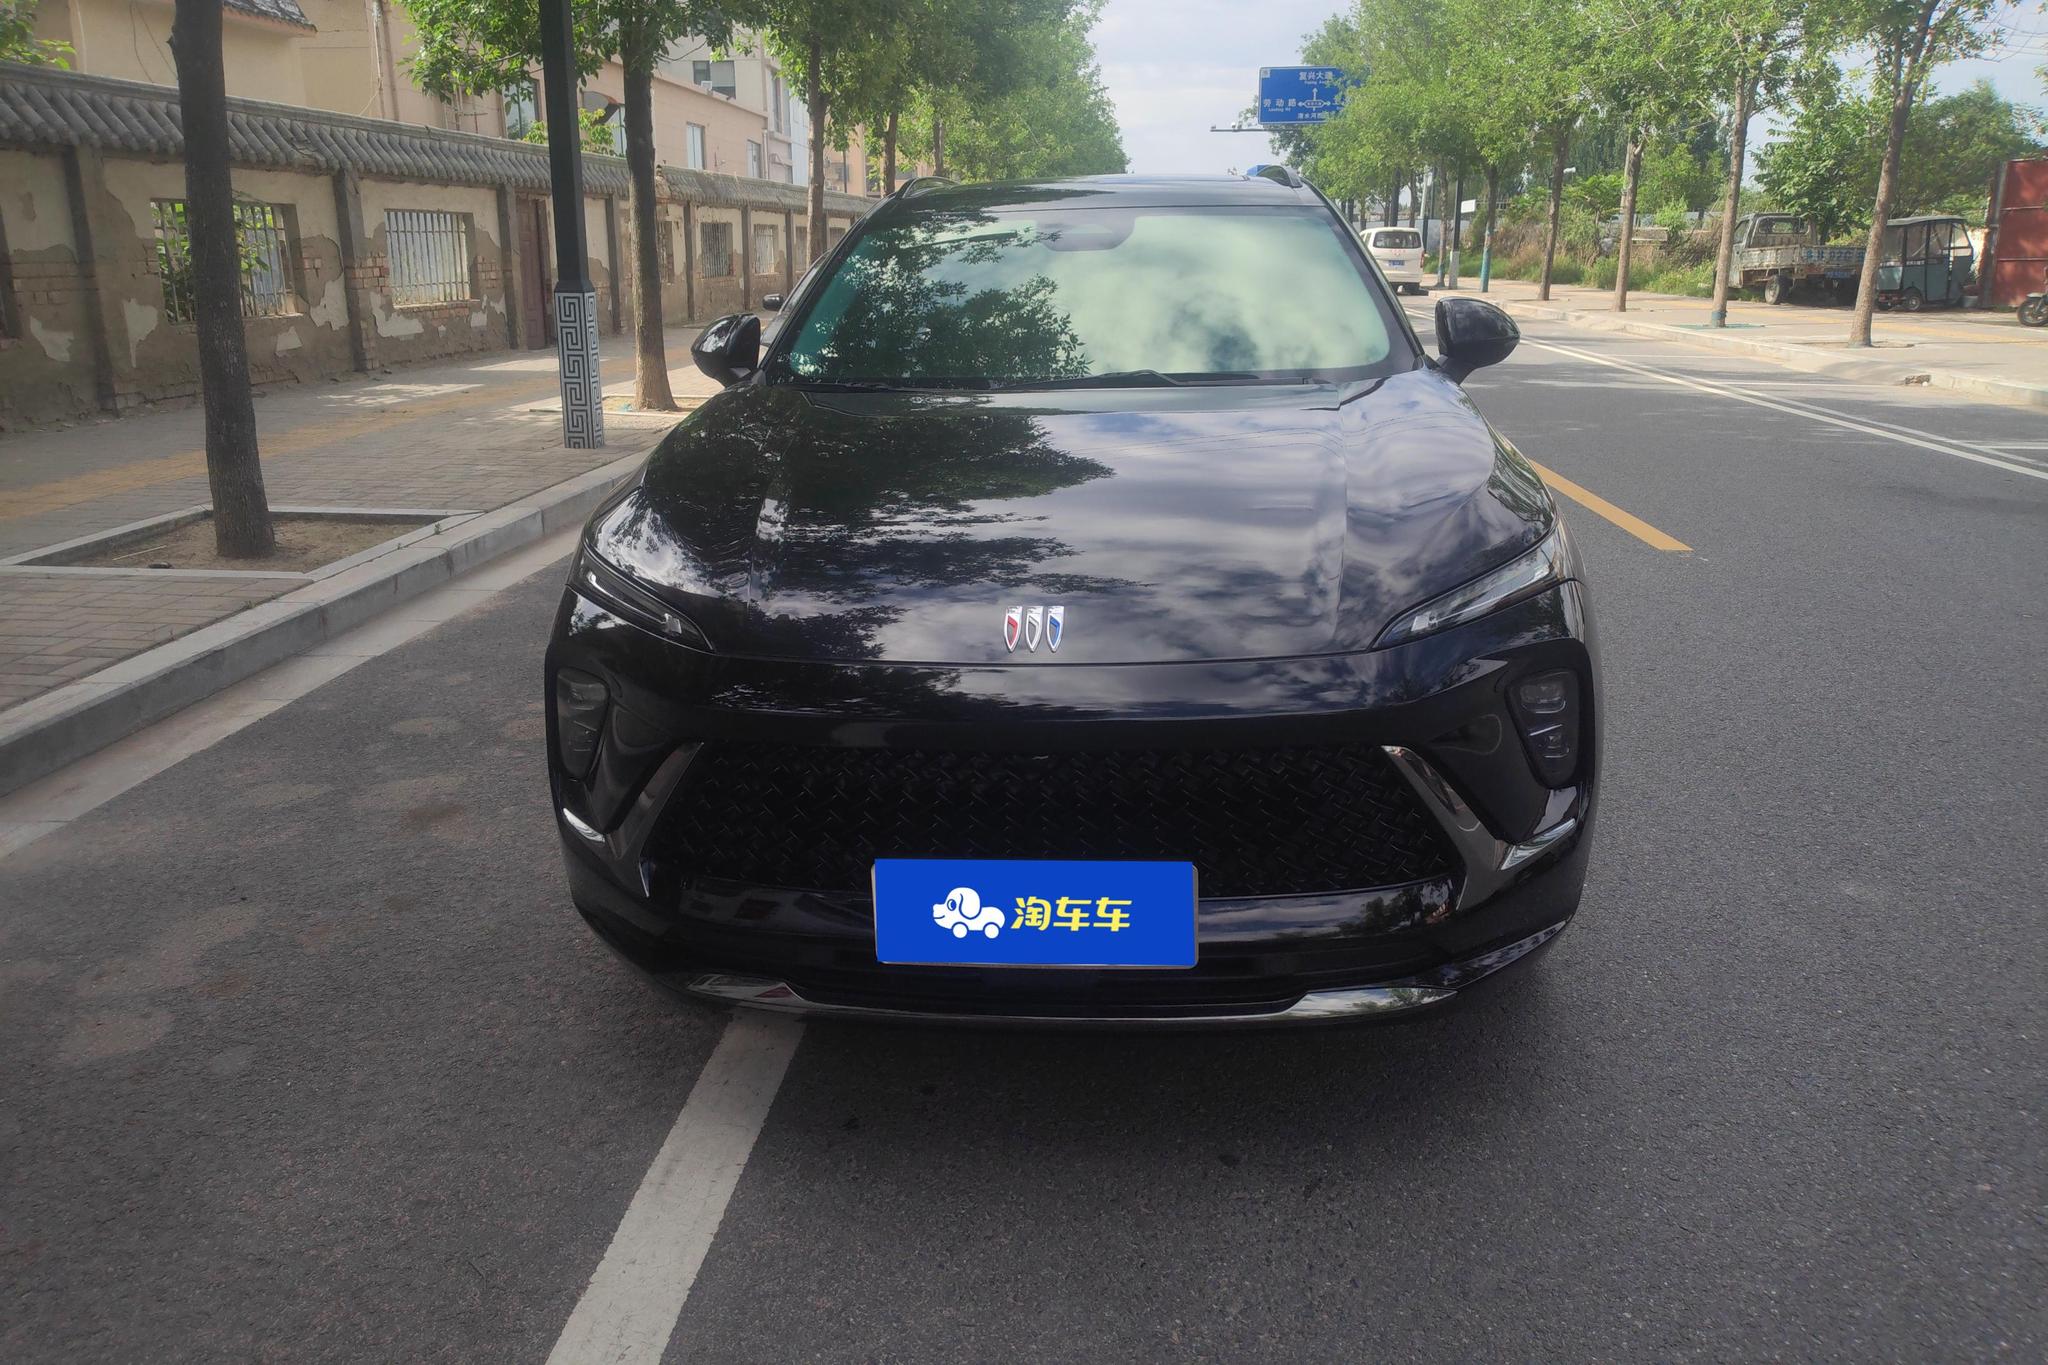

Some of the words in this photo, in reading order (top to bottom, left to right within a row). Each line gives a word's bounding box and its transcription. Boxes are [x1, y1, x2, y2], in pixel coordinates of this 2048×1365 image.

[1299, 71, 1333, 81] 复兴大道
[1263, 98, 1297, 107] 劳动路
